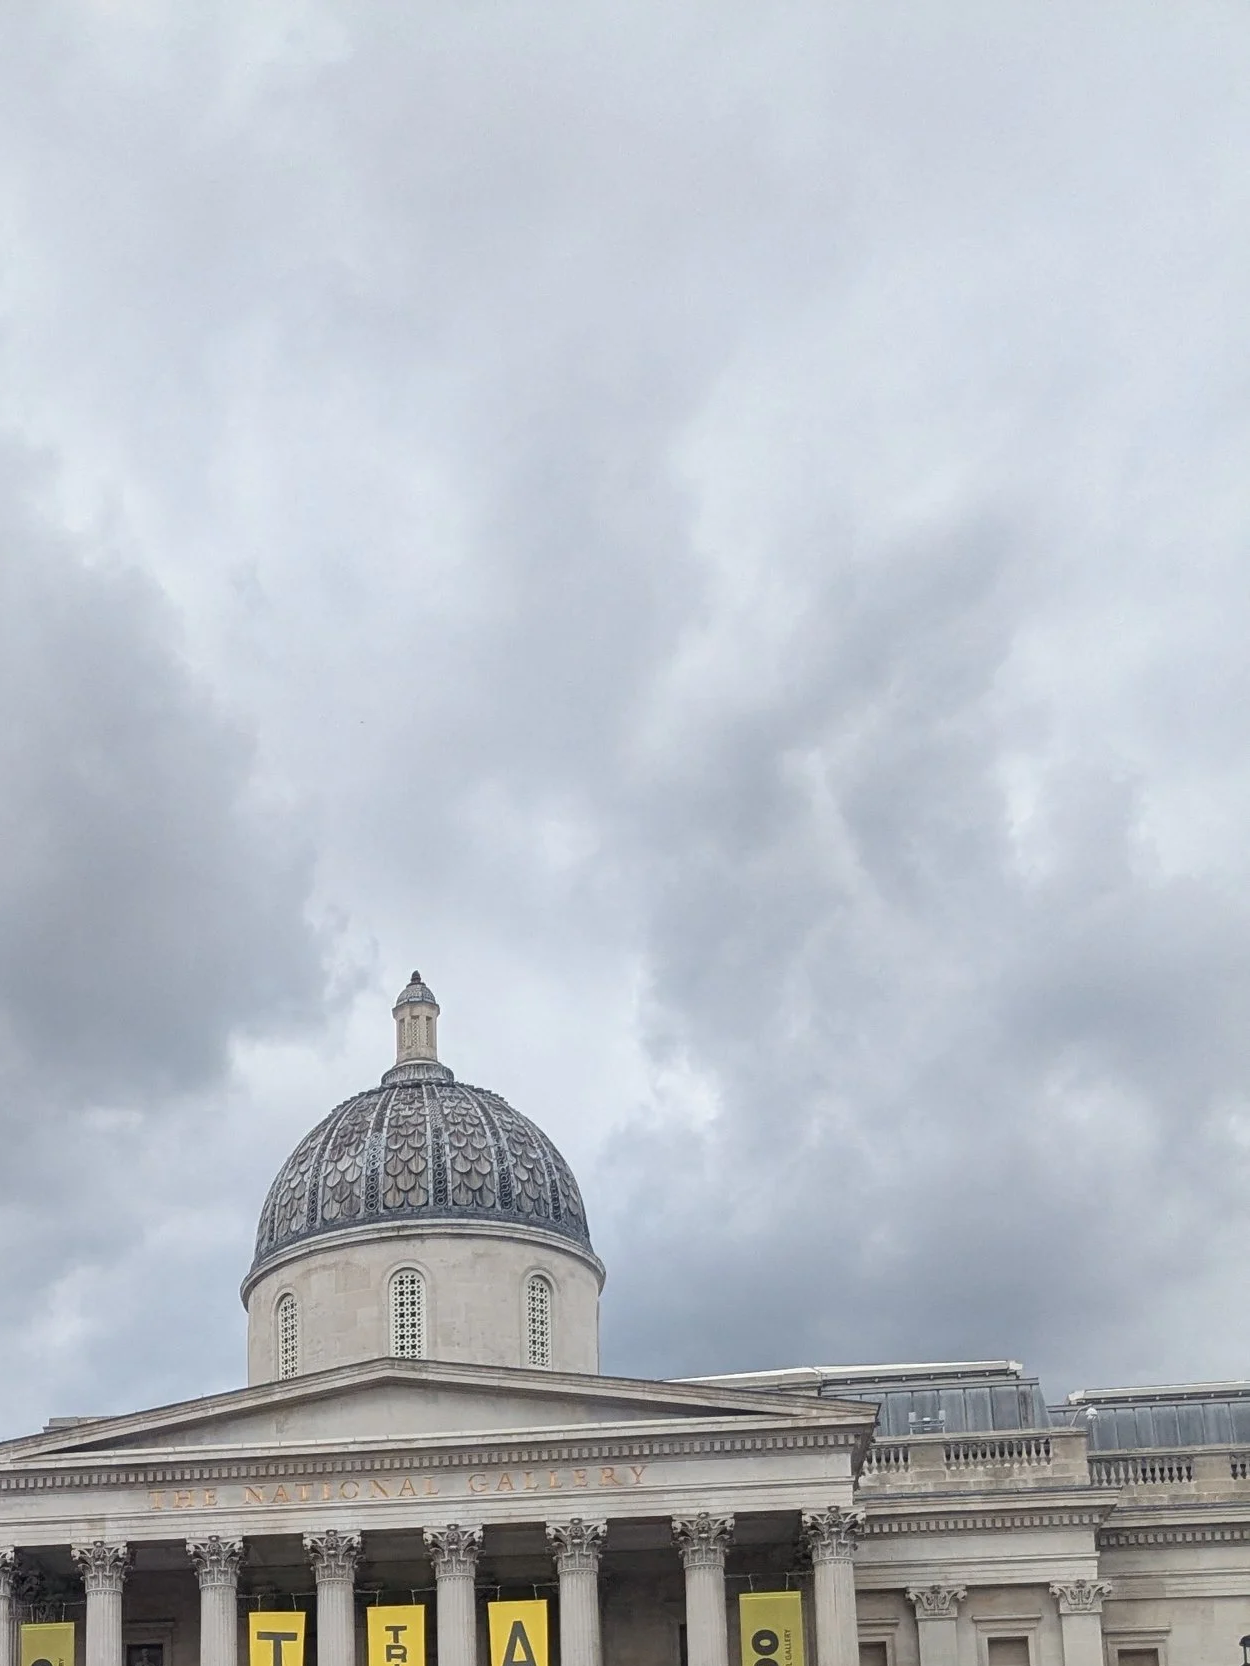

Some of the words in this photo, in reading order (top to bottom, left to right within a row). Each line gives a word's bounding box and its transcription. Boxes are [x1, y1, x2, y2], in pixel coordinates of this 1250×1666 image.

[149, 1488, 218, 1510] THE
[244, 1477, 440, 1504] NATIONAL
[468, 1465, 647, 1493] GALLERY
[784, 1629, 792, 1660] GALLERY
